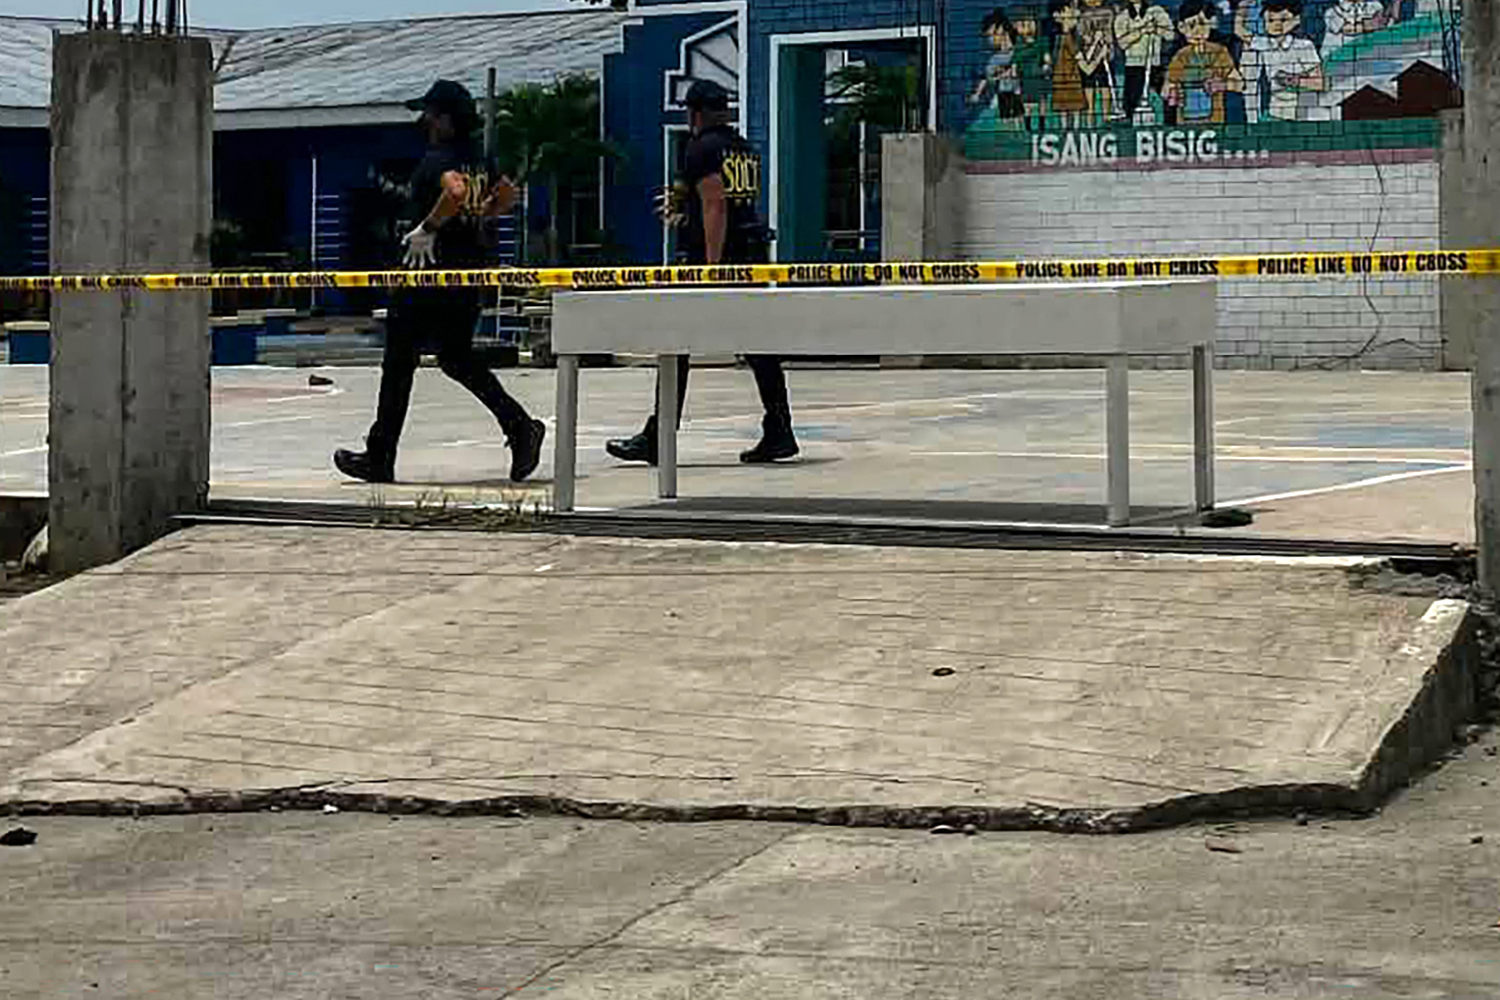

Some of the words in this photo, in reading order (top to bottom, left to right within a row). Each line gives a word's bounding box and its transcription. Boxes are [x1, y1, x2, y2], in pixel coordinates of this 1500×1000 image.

[1032, 132, 1117, 167] ISANG
[788, 265, 833, 279] POLICE
[840, 265, 867, 280] LINE
[874, 265, 893, 279] DO
[898, 264, 926, 279] NOT
[932, 263, 979, 279] CROSS
[1015, 262, 1064, 278] POLICE
[1070, 262, 1103, 277] LINE
[1107, 262, 1127, 276] DO
[1134, 261, 1161, 276] NOT
[1169, 260, 1219, 275] CROSS
[1258, 258, 1308, 274] POLICE
[1314, 257, 1346, 274] LINE
[1352, 256, 1372, 272] DO
[1379, 255, 1409, 271] NOT
[1416, 253, 1467, 271] CROSS
[368, 274, 406, 286] POLICE
[497, 271, 540, 284] CROSS
[572, 270, 617, 285] POLICE
[653, 269, 672, 282] DO
[677, 269, 704, 282] NOT
[708, 268, 753, 281] CROSS
